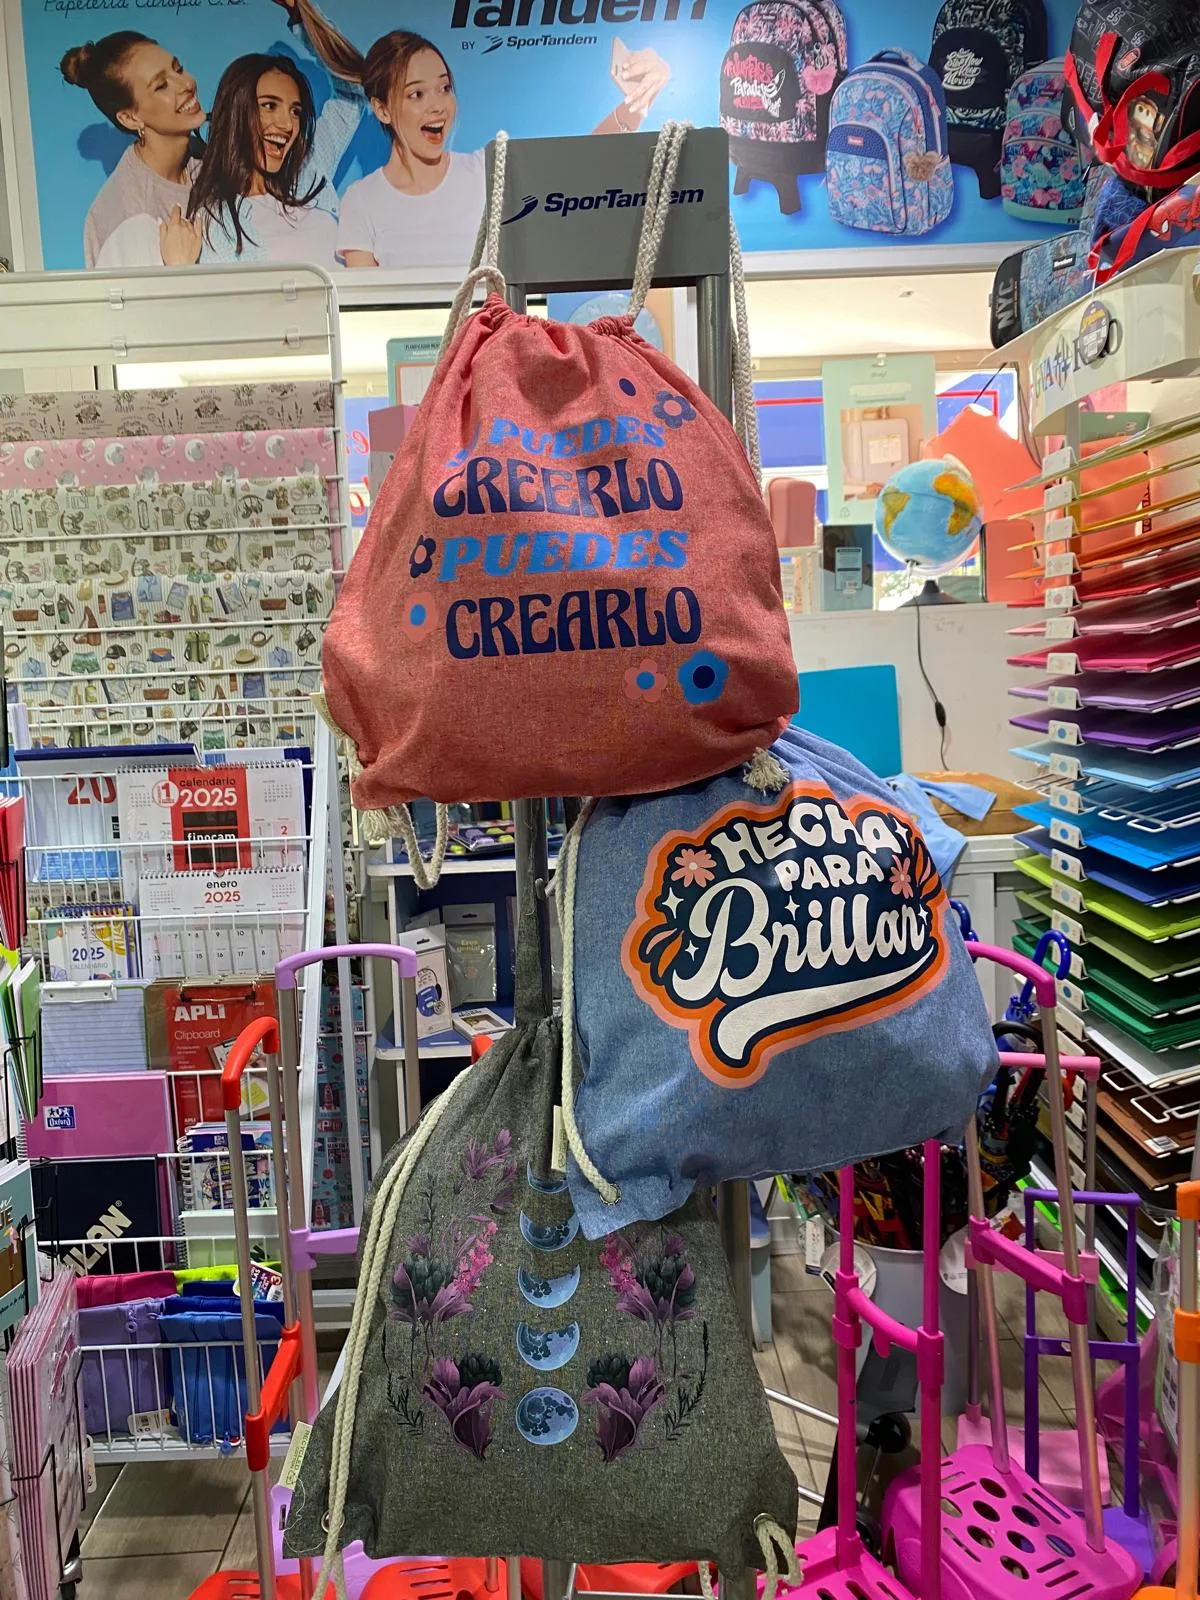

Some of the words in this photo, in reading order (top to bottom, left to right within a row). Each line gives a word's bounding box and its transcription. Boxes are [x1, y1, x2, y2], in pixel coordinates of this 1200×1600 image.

[462, 41, 475, 50] BY
[506, 34, 597, 50] SporTandem
[544, 188, 705, 217] SporTanem
[998, 277, 1014, 329] NYC
[487, 415, 666, 459] PUEDES
[433, 456, 684, 518] CREERLO
[436, 530, 689, 583] PUEDES
[446, 586, 702, 659] CREARLO
[179, 777, 236, 787] calendario
[180, 787, 238, 808] 2025
[281, 825, 288, 835] 2
[711, 802, 902, 873] HECHA
[206, 879, 238, 889] enero
[775, 850, 884, 892] PARA
[204, 891, 241, 903] 2025
[672, 877, 926, 1001] Brillar
[72, 947, 105, 961] 2025
[174, 1003, 226, 1022] APLI
[174, 1028, 221, 1041] Clipboard
[49, 1117, 72, 1127] Oxford
[63, 1204, 133, 1277] ILAN
[294, 1429, 311, 1471] RECYCLED
